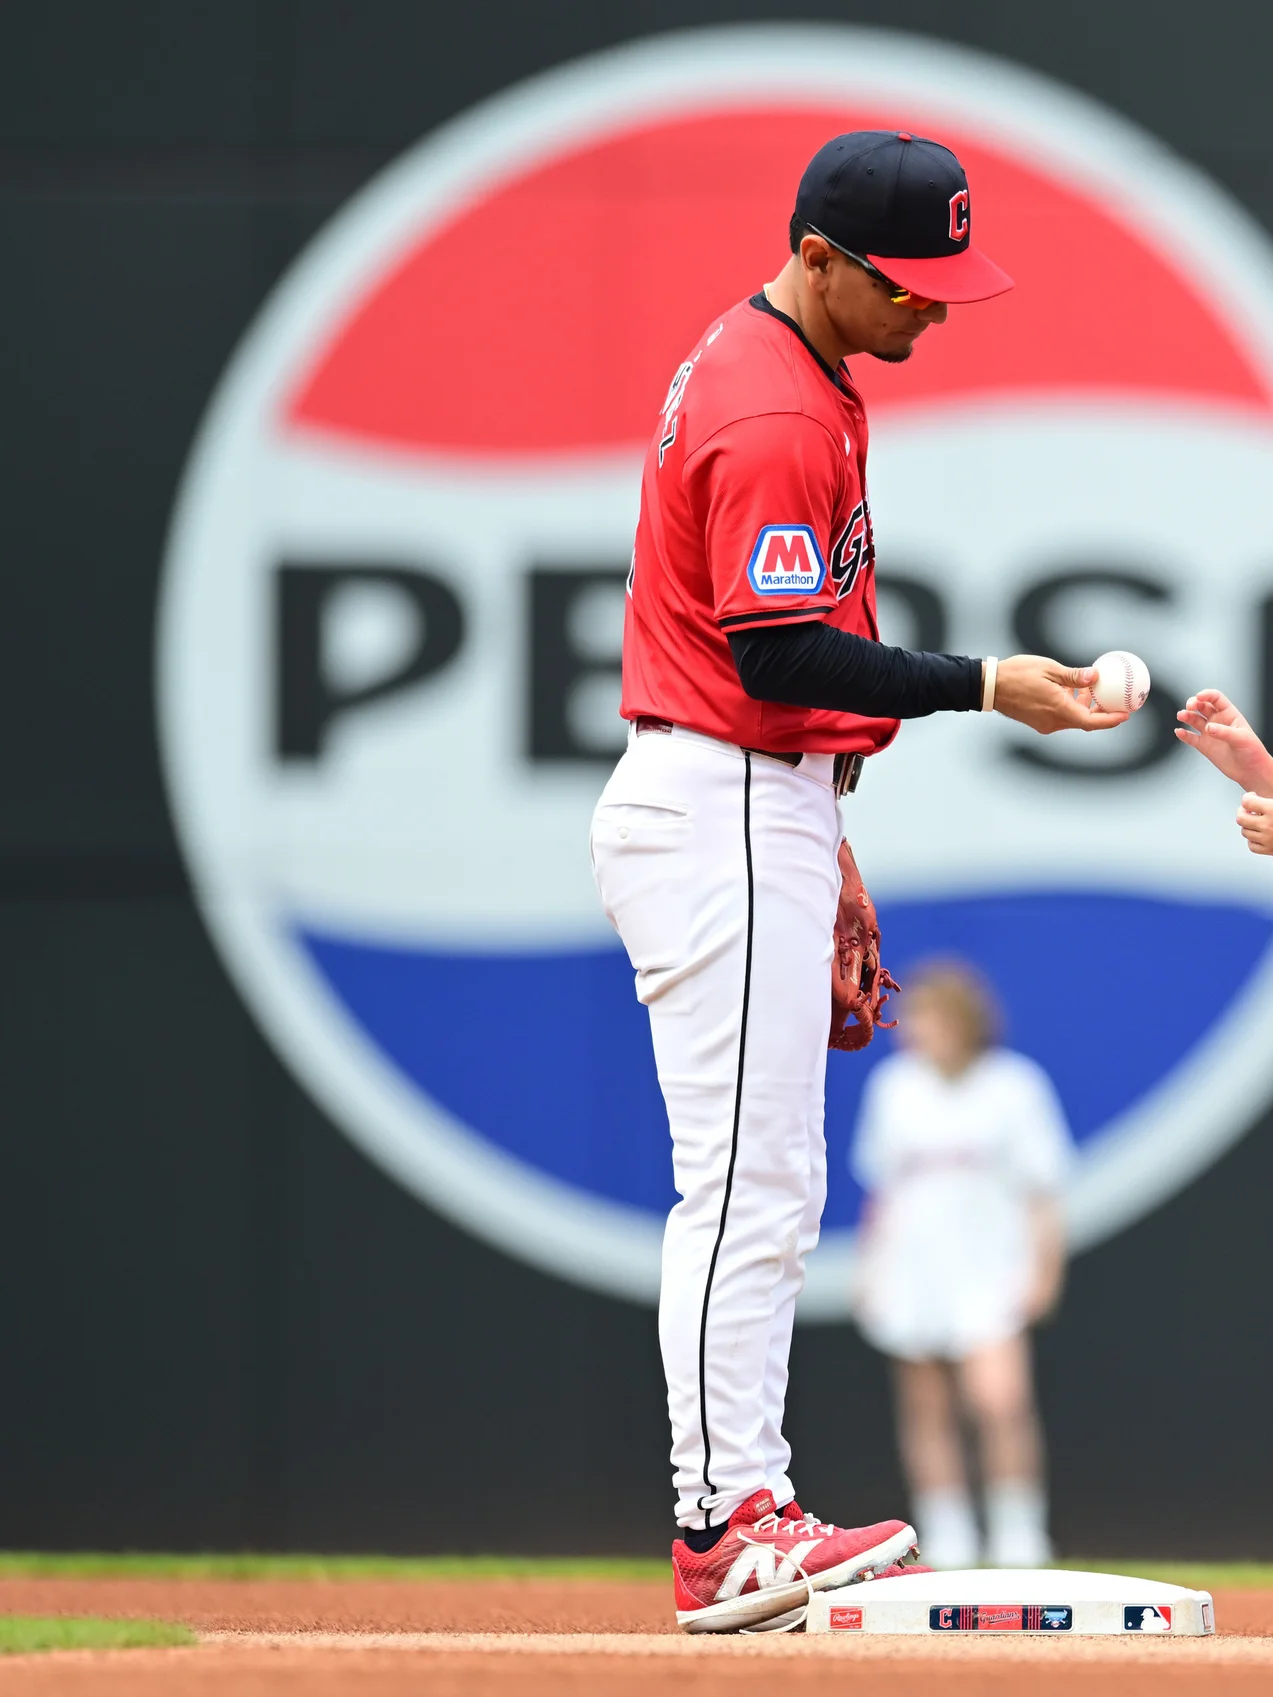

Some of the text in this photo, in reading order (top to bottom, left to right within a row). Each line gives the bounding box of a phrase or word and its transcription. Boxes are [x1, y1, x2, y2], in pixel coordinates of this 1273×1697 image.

[949, 189, 968, 241] C
[762, 535, 812, 573] M
[761, 574, 813, 585] Marathon
